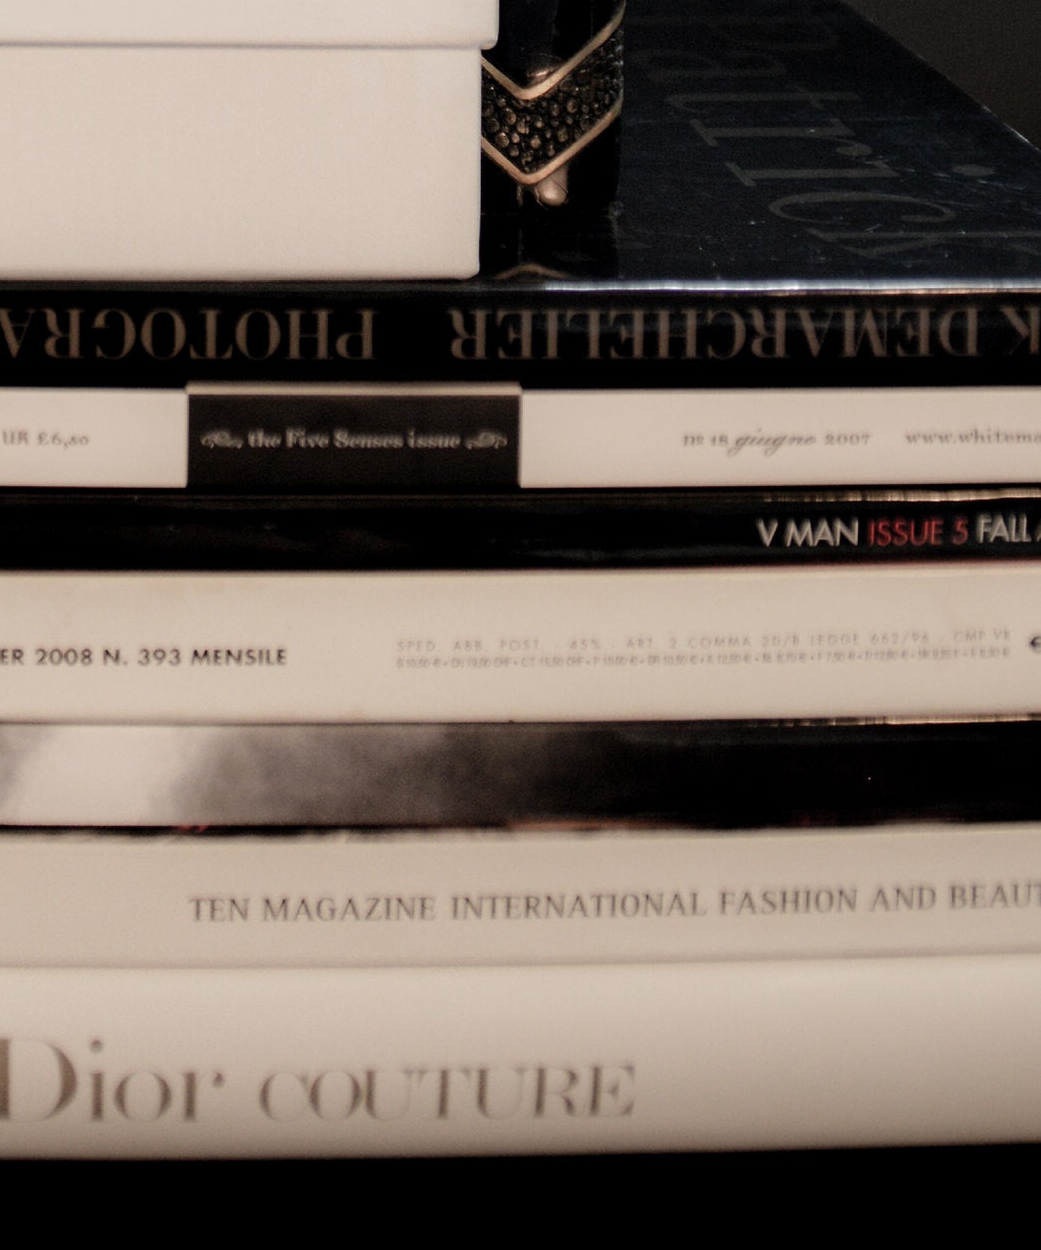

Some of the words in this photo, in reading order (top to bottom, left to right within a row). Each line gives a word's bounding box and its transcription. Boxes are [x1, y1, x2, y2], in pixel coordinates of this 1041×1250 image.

[449, 306, 985, 360] DEMARCHELIER
[248, 428, 281, 448] the
[285, 426, 329, 448] Five
[333, 428, 404, 448] Senses
[407, 428, 460, 448] issue
[825, 433, 872, 446] 2007
[757, 518, 778, 547] V
[785, 517, 859, 547] MAN
[868, 517, 943, 546] ISSUE
[952, 516, 970, 545] 5
[977, 513, 1032, 543] FALL
[35, 647, 94, 667] 2008
[103, 648, 129, 667] N.
[137, 648, 183, 667] 393
[191, 647, 287, 667] MENSILE
[189, 897, 250, 923] TEN
[261, 895, 437, 922] MAGAZINE
[450, 892, 707, 920] INTERNATIONAL
[718, 888, 859, 917] FASHION
[869, 885, 938, 913] AND
[258, 1060, 637, 1123] COUTURE
